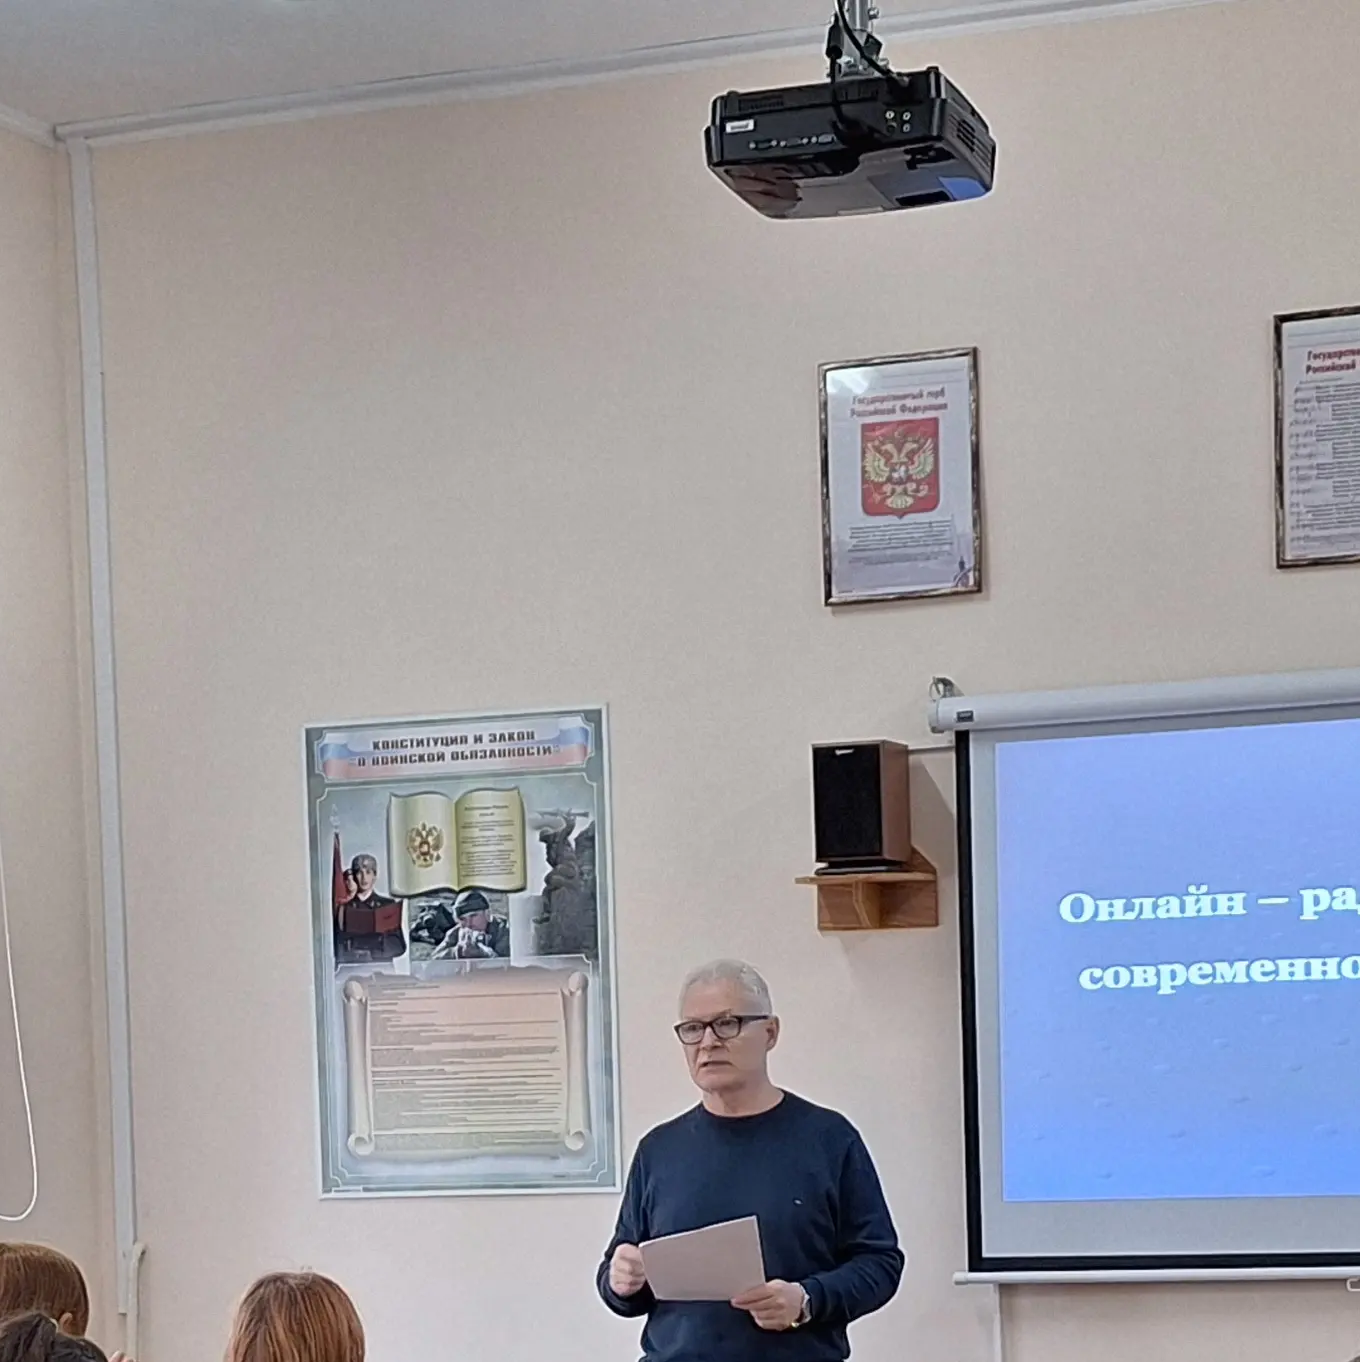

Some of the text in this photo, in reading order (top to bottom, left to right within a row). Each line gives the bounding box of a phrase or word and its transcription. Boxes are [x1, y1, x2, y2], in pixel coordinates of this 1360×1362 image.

[1306, 359, 1356, 374] Российской
[372, 730, 535, 751] КОНСТИТУЦИЯ И ЗАКОН
[371, 751, 446, 766] ВОИНСКОЙ
[1059, 884, 1247, 923] Онлайн
